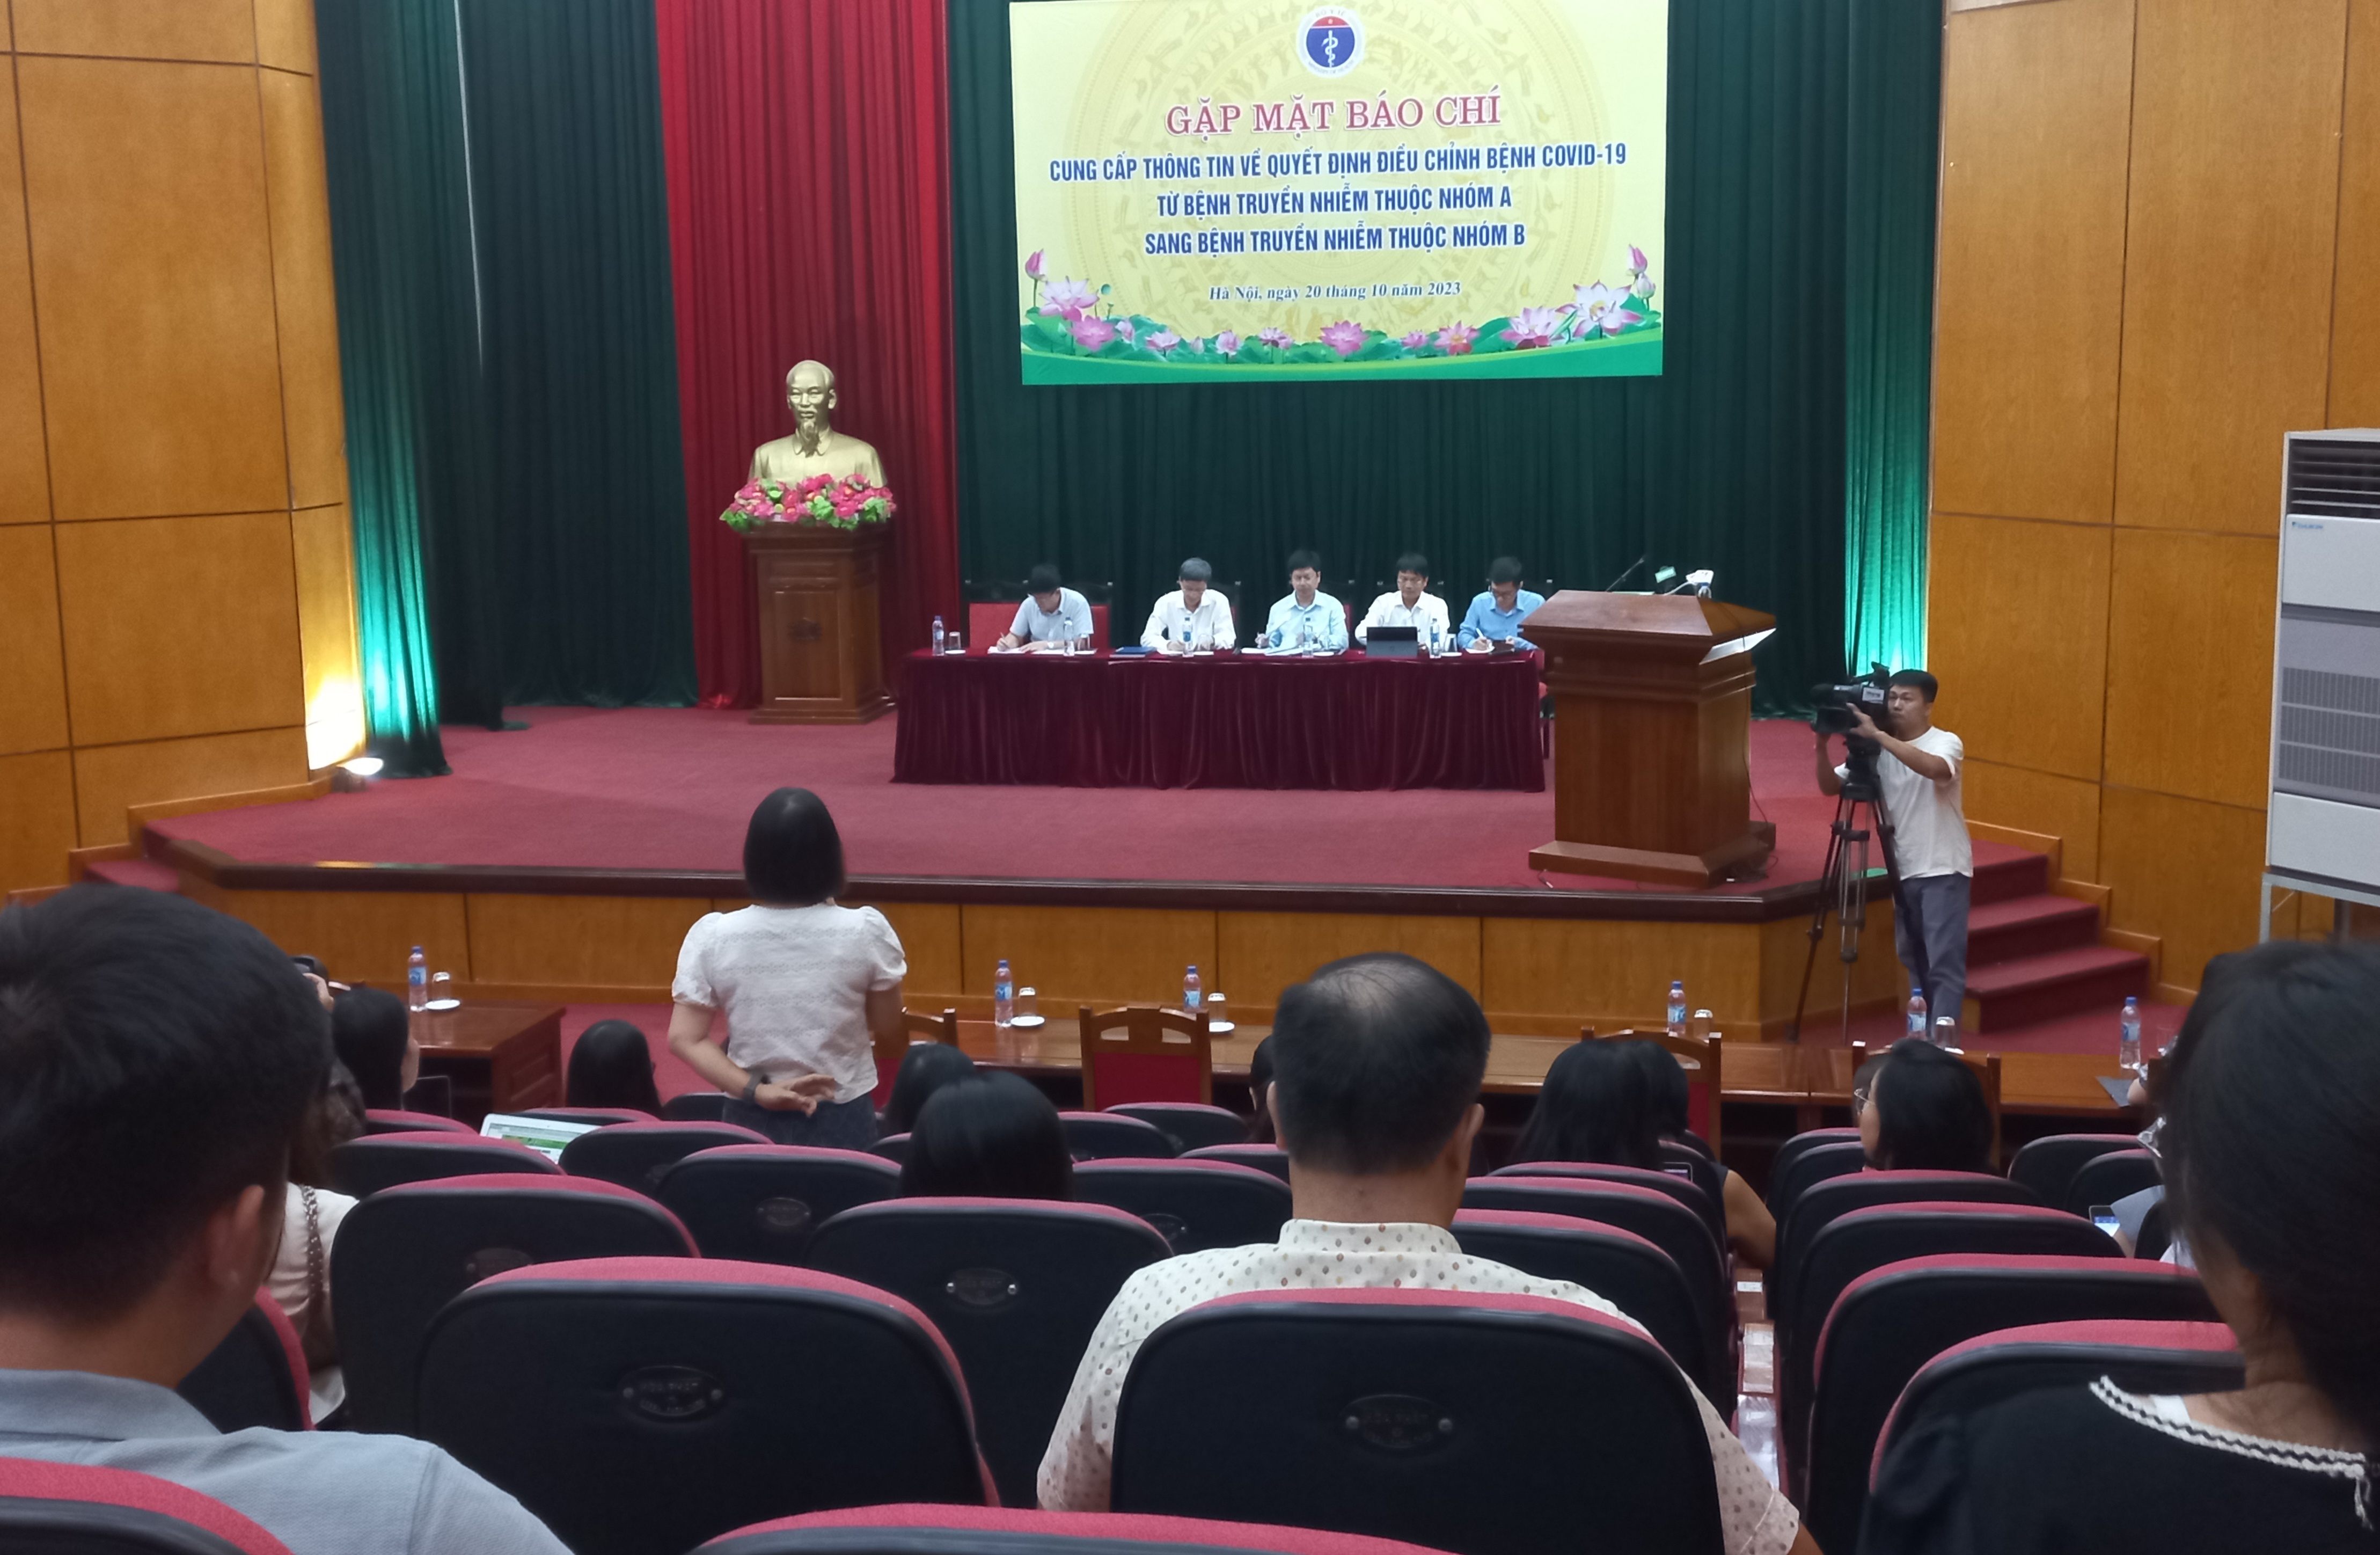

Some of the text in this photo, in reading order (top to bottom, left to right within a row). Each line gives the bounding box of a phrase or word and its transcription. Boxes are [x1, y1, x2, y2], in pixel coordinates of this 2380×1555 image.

[1166, 84, 1501, 141] GẶP MẶT BÁO CHÍ
[1049, 141, 1627, 182] CUNG CẤP THÔNG TIN VỀ QUYẾT ĐỊNH ĐIỀU CHỈNH BỆNH COVID-19
[1156, 182, 1512, 221] TỪ BỆNH TRUYỀN NHIỄM THUỘC NHÓM A
[1145, 220, 1526, 258] SANG BỆNH TRUYỀN NHIỄM THUỘC NHÓM B
[1209, 282, 1461, 303] Hà Nội, ngày 20 tháng 10 năm 2023
